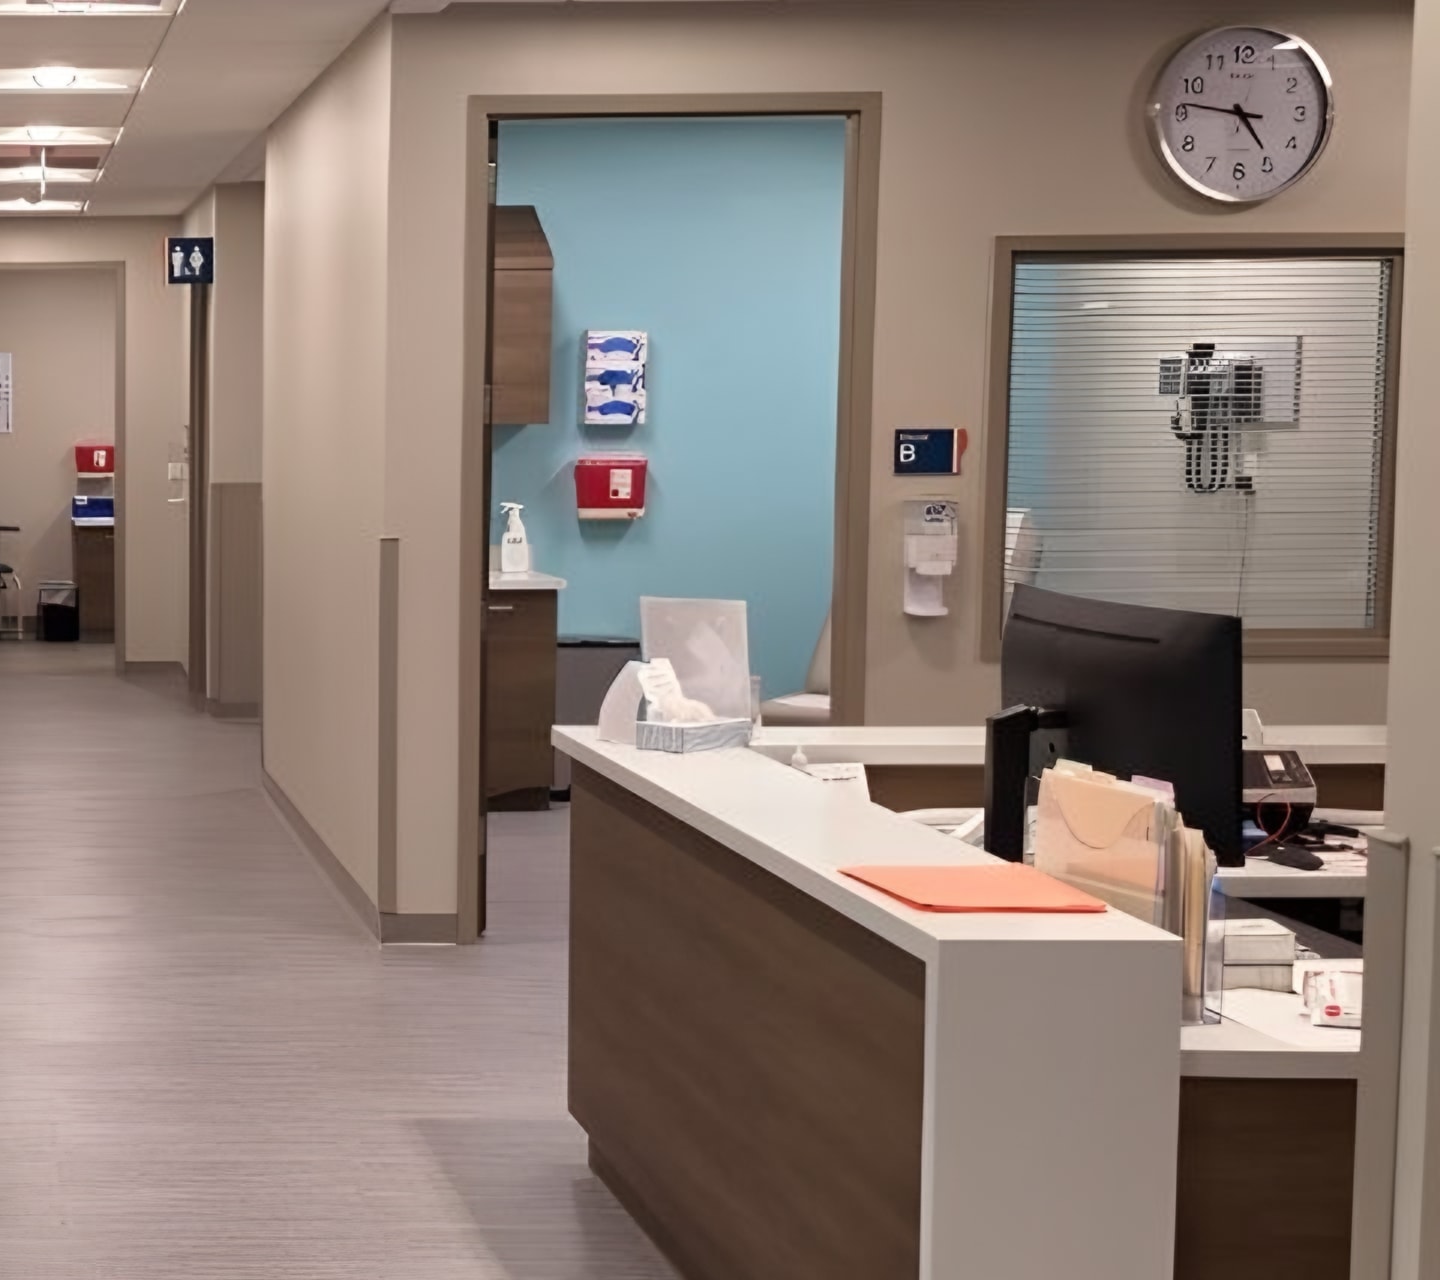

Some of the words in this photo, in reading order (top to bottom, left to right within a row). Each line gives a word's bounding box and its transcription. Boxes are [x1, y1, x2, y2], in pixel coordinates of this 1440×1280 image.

[1206, 54, 1225, 70] 11
[1233, 45, 1256, 64] 12
[1183, 76, 1204, 94] 10
[1285, 77, 1298, 94] 2
[1293, 105, 1306, 122] 3
[1181, 135, 1195, 152] 8
[1205, 156, 1217, 173] 7
[1232, 162, 1246, 180] 6
[899, 443, 916, 463] B
